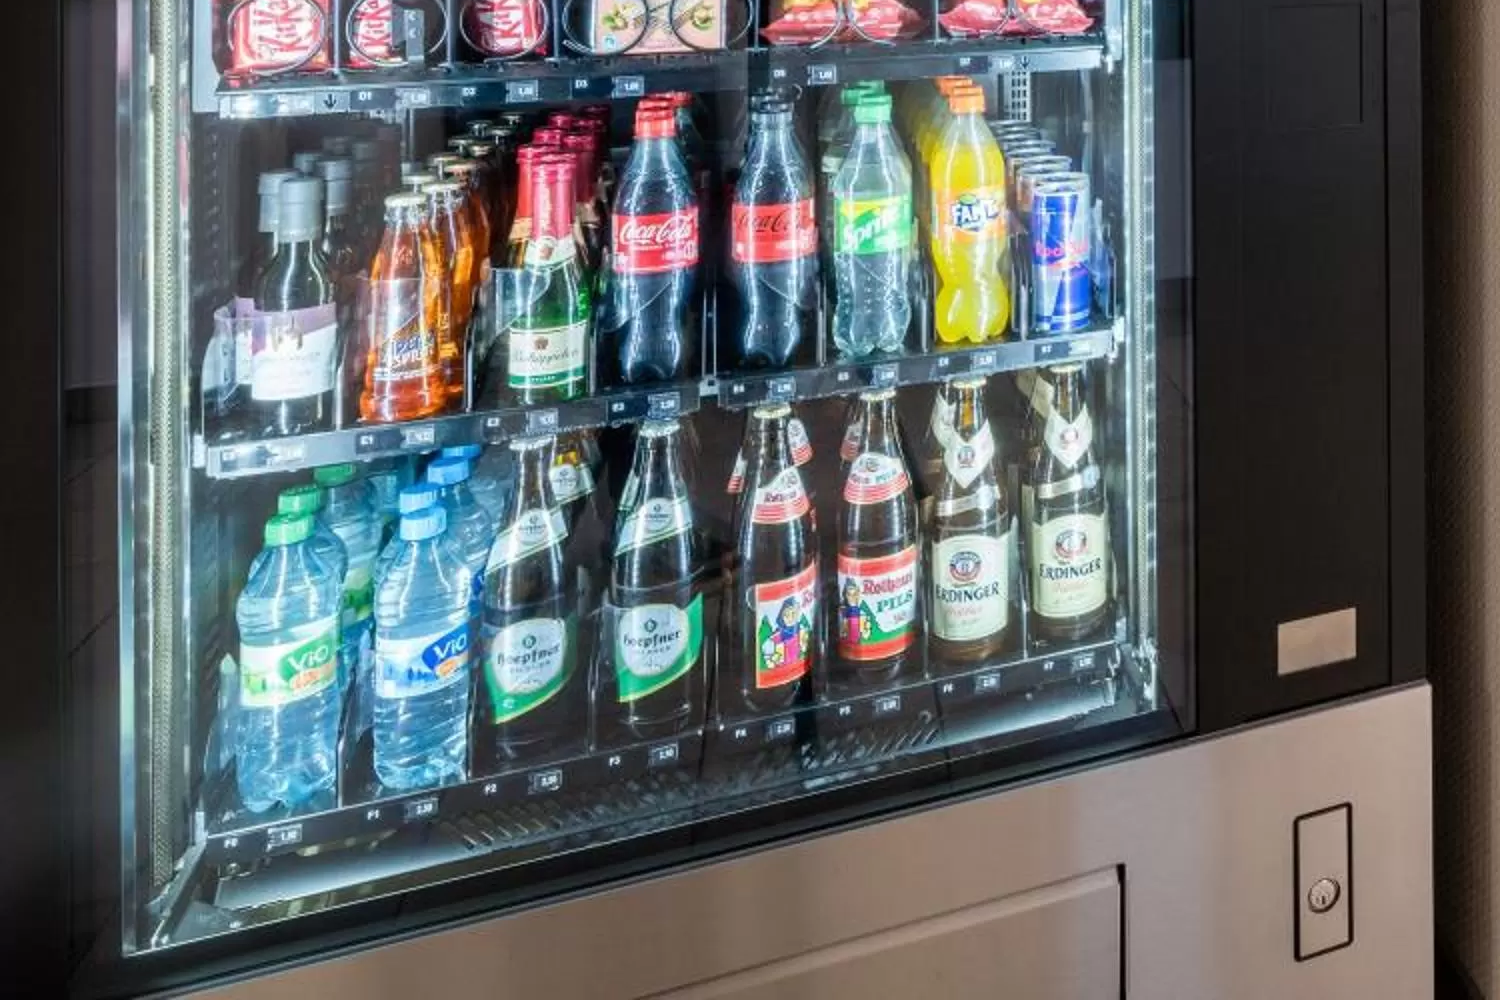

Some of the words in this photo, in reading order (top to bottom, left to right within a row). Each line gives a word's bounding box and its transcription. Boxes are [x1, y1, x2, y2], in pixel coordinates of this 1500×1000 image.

[619, 213, 694, 247] Coca-Cola
[1039, 557, 1102, 582] ERDINGER
[875, 589, 914, 614] PILS
[935, 581, 1000, 604] ERDINGER
[623, 630, 682, 649] hoepfner
[484, 782, 497, 795] F2
[367, 808, 380, 821] F1
